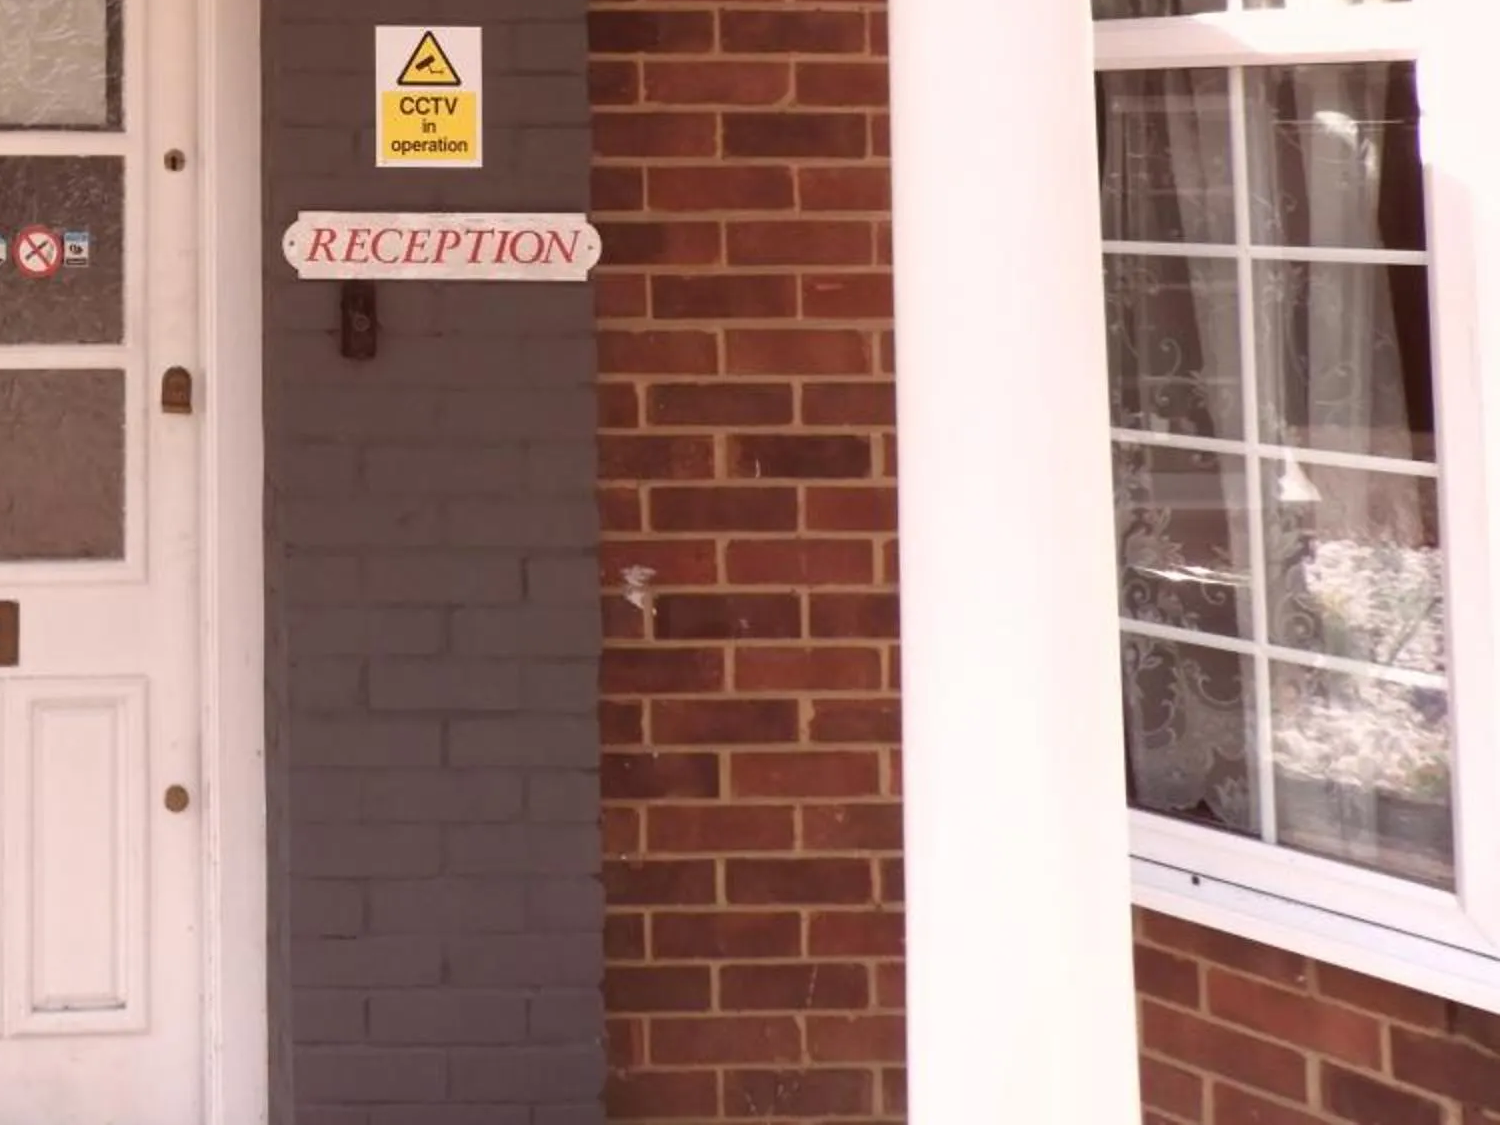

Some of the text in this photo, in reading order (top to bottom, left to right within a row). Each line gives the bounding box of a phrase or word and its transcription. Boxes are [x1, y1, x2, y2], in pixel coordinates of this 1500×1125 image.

[399, 97, 458, 115] CCTV
[422, 119, 436, 133] in
[391, 137, 468, 154] operation
[305, 229, 581, 264] RECEPTION
